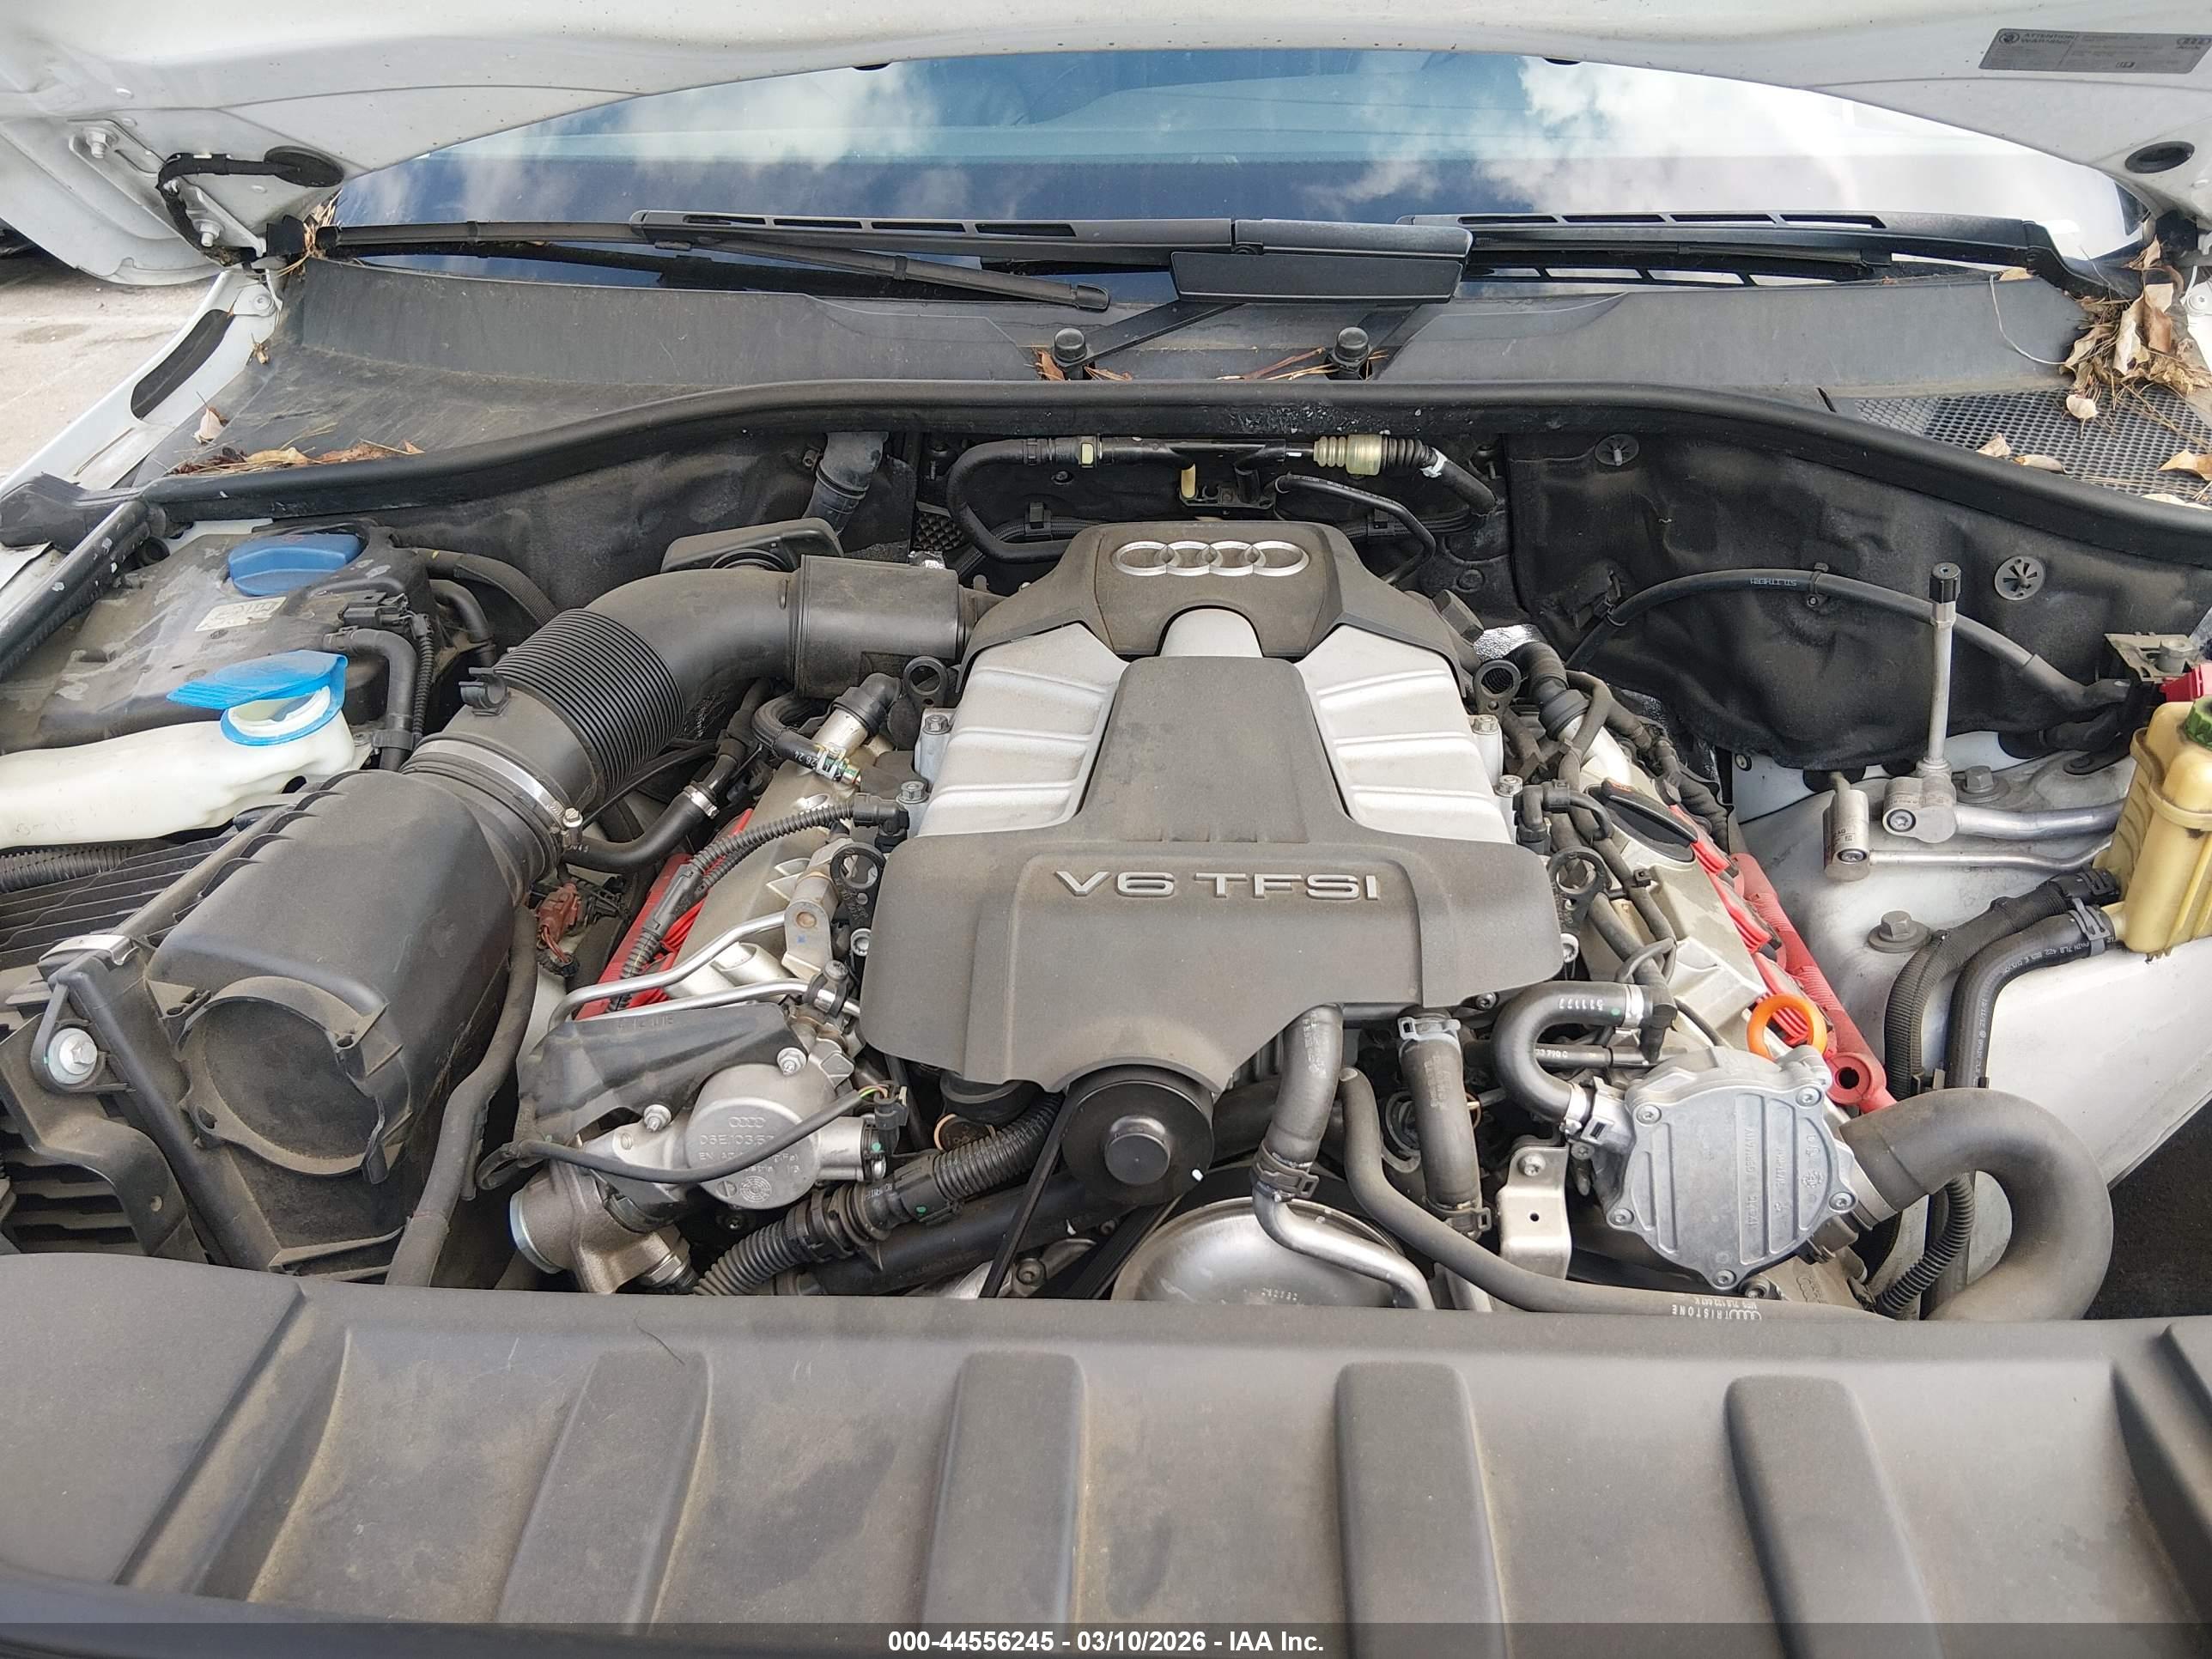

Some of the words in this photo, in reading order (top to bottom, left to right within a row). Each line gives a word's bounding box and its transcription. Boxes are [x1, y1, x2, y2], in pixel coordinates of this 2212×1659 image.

[1054, 870, 1176, 898] V6
[1194, 872, 1380, 902] TFSI
[1671, 1304, 1729, 1320] TRISTONE
